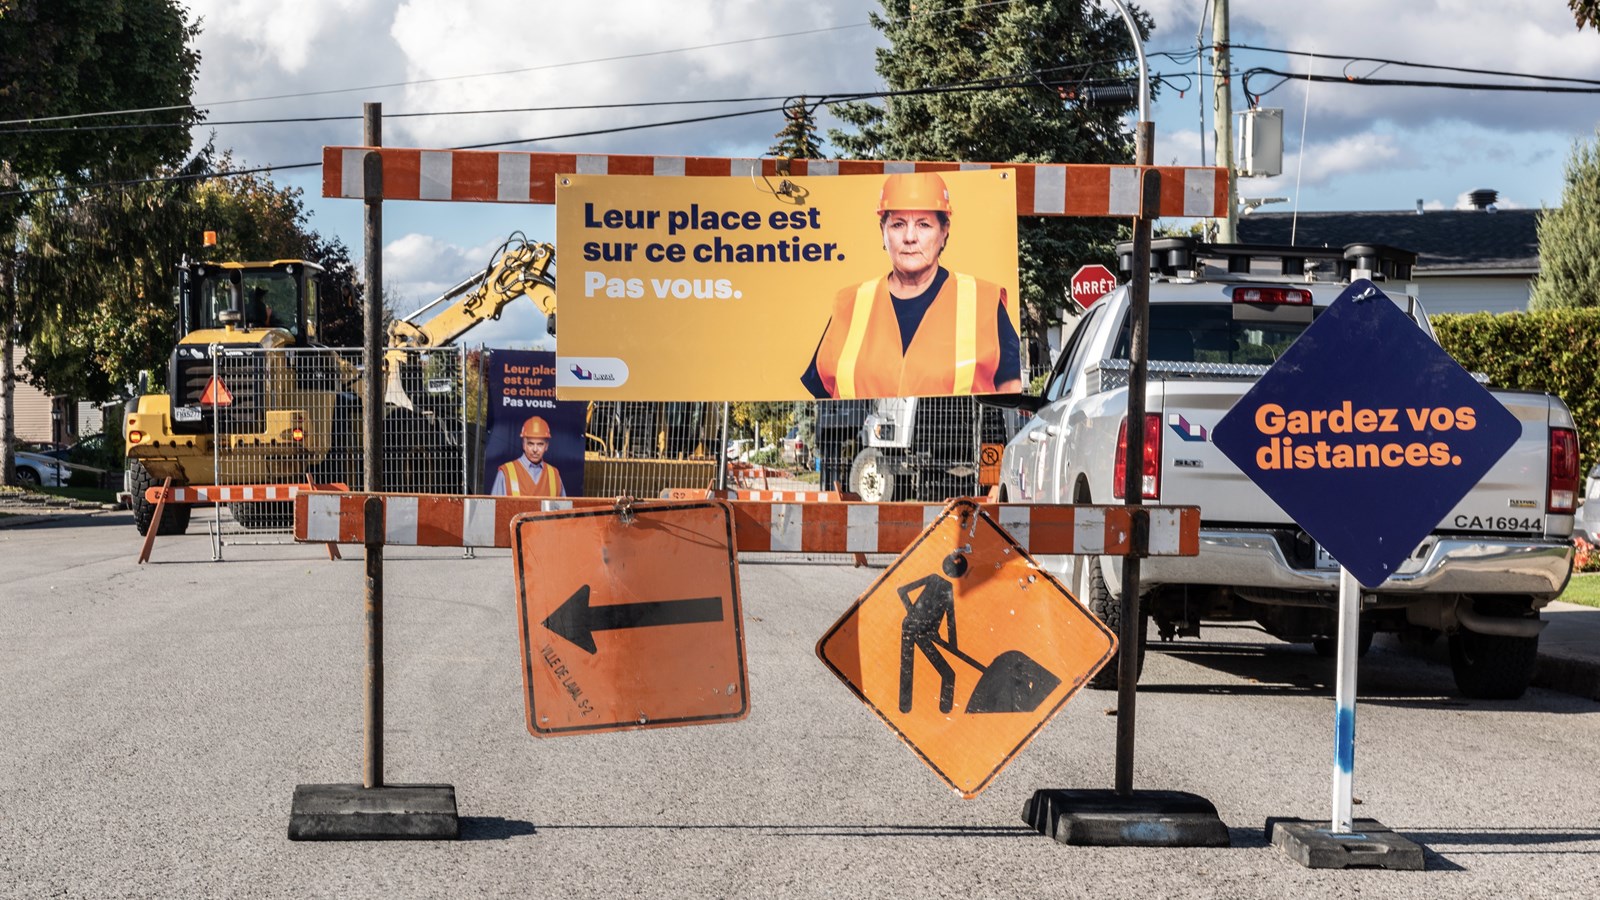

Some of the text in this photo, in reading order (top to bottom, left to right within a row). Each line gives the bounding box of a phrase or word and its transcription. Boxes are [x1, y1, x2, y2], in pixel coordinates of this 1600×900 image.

[584, 203, 821, 236] Leur place est
[583, 236, 846, 263] sur ce chantier.
[584, 272, 743, 300] Pas vous.
[1075, 278, 1114, 295] ARRÊT
[503, 364, 556, 376] Leur plac
[503, 376, 542, 386] est sur
[503, 387, 556, 398] ce chanti
[503, 397, 556, 409] Pas vous.
[1255, 401, 1477, 435] Gardez vos
[1256, 437, 1462, 470] distances.
[1454, 514, 1543, 531] CA16944
[554, 664, 569, 680] DE
